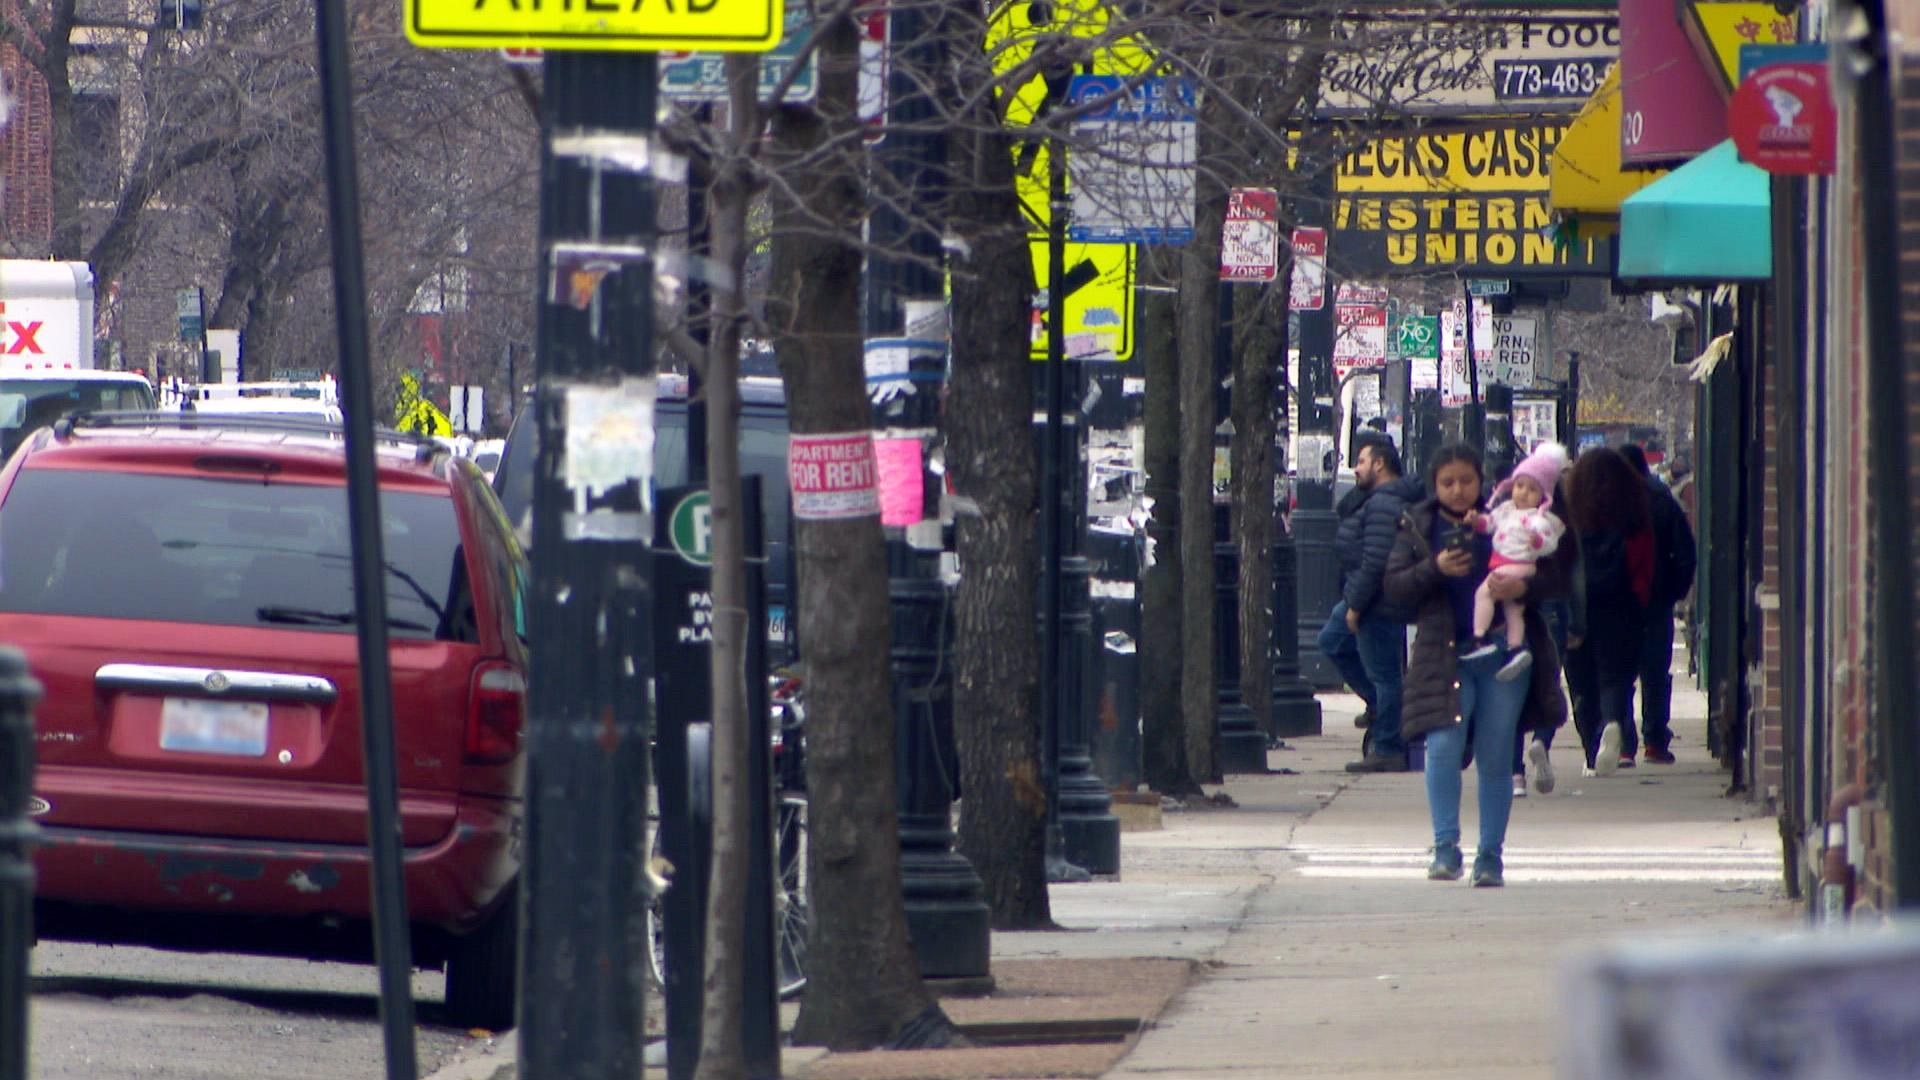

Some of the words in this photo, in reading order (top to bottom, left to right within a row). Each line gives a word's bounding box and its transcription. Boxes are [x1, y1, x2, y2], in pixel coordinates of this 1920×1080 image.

[1336, 197, 1551, 231] ESTERN
[1387, 232, 1556, 265] UNION
[1492, 320, 1512, 333] NO
[1499, 350, 1531, 365] RED
[792, 462, 820, 489] FOR
[825, 458, 872, 488] RENT
